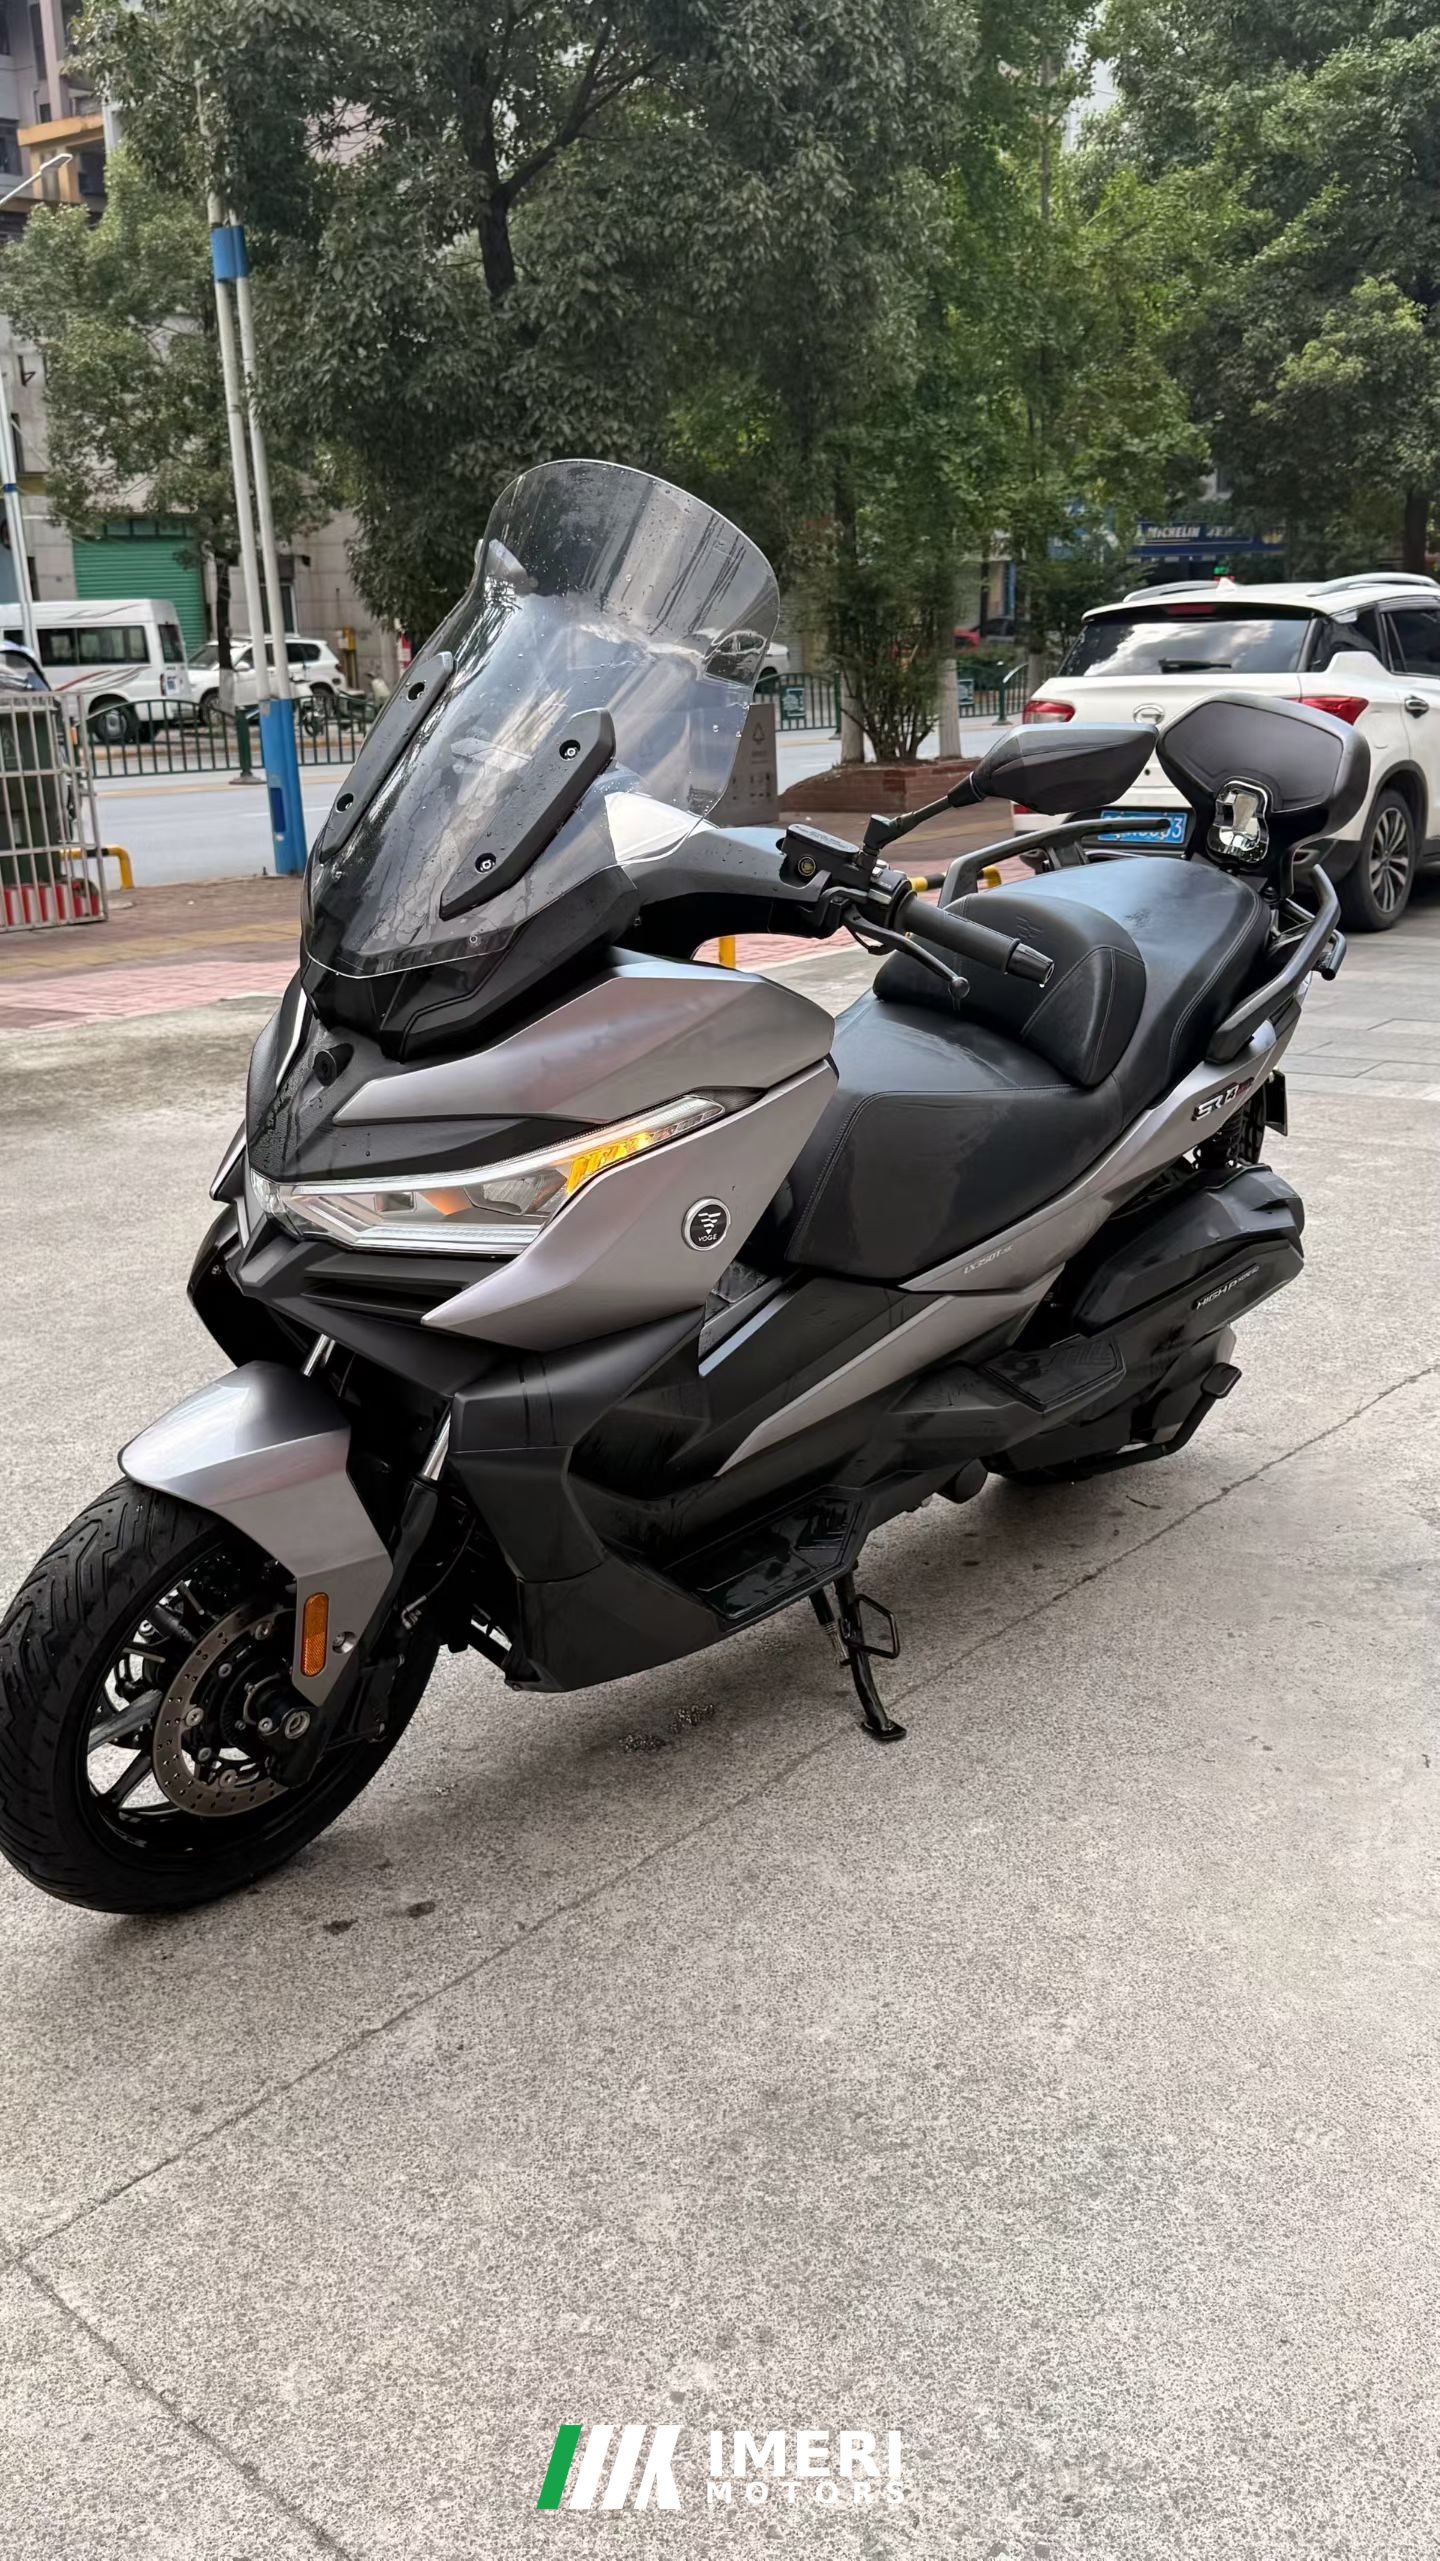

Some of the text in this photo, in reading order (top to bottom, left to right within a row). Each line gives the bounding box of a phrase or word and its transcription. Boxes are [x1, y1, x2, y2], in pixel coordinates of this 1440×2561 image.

[1147, 526, 1200, 538] MICHELIN
[698, 1233, 718, 1242] VOGE
[1196, 1285, 1228, 1310] HIGH
